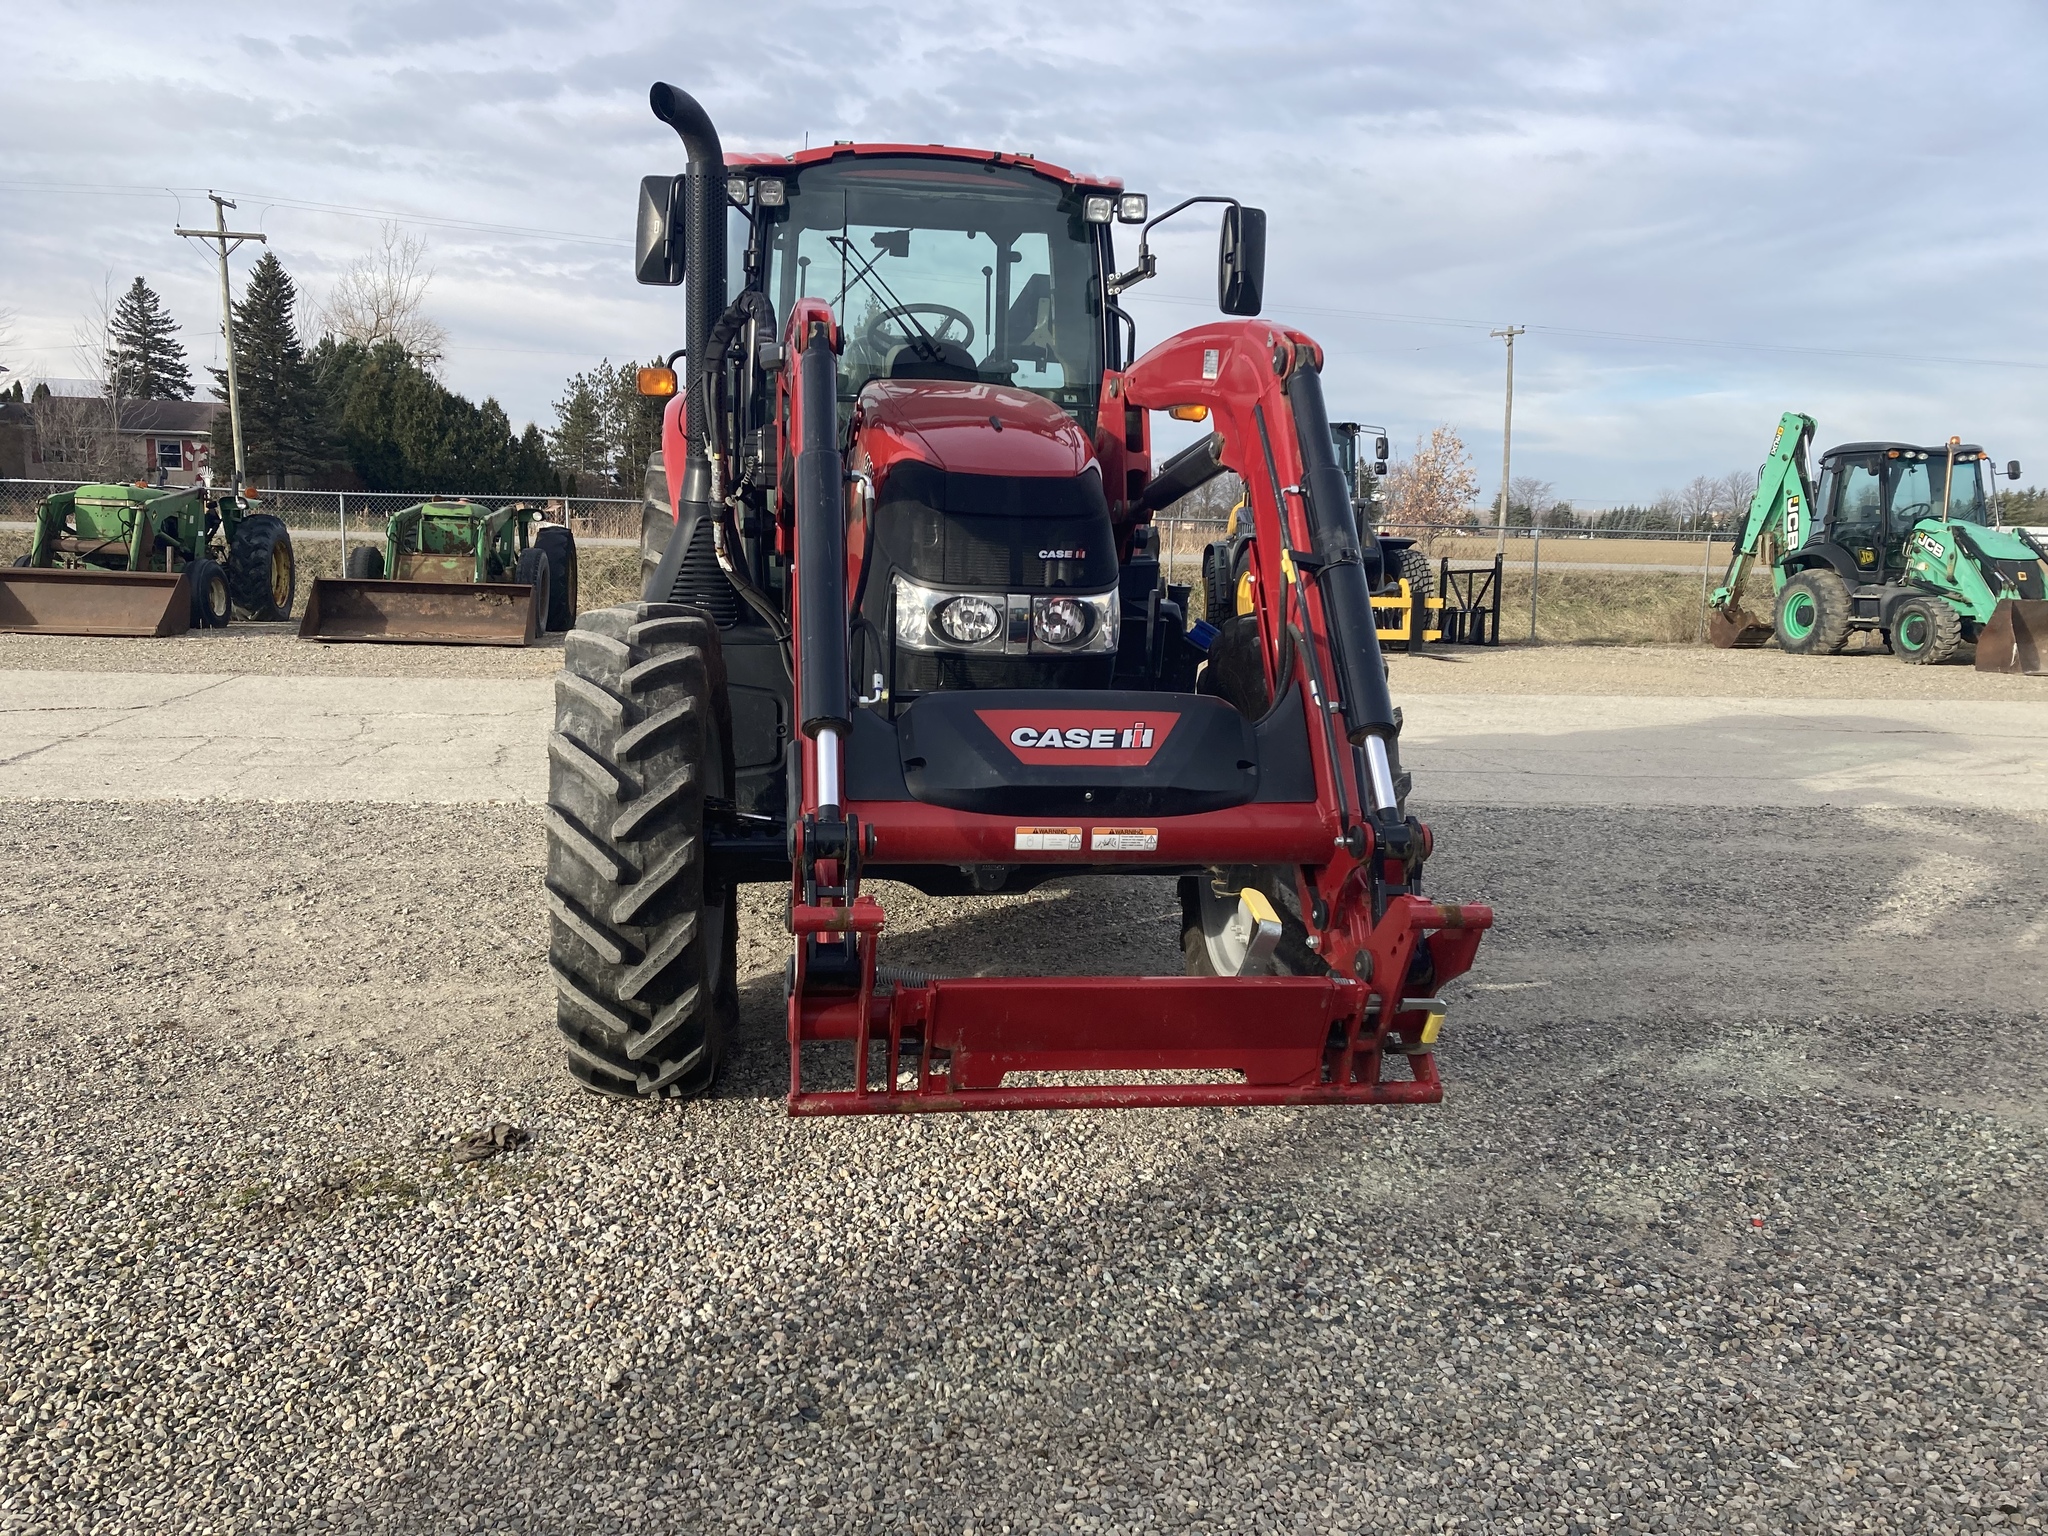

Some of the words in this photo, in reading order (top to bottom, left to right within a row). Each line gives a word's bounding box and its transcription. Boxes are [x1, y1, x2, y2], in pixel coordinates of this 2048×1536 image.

[1787, 496, 1799, 551] JCB
[1038, 550, 1073, 559] CASE
[1917, 532, 1945, 559] JCB
[1010, 727, 1116, 749] CASE
